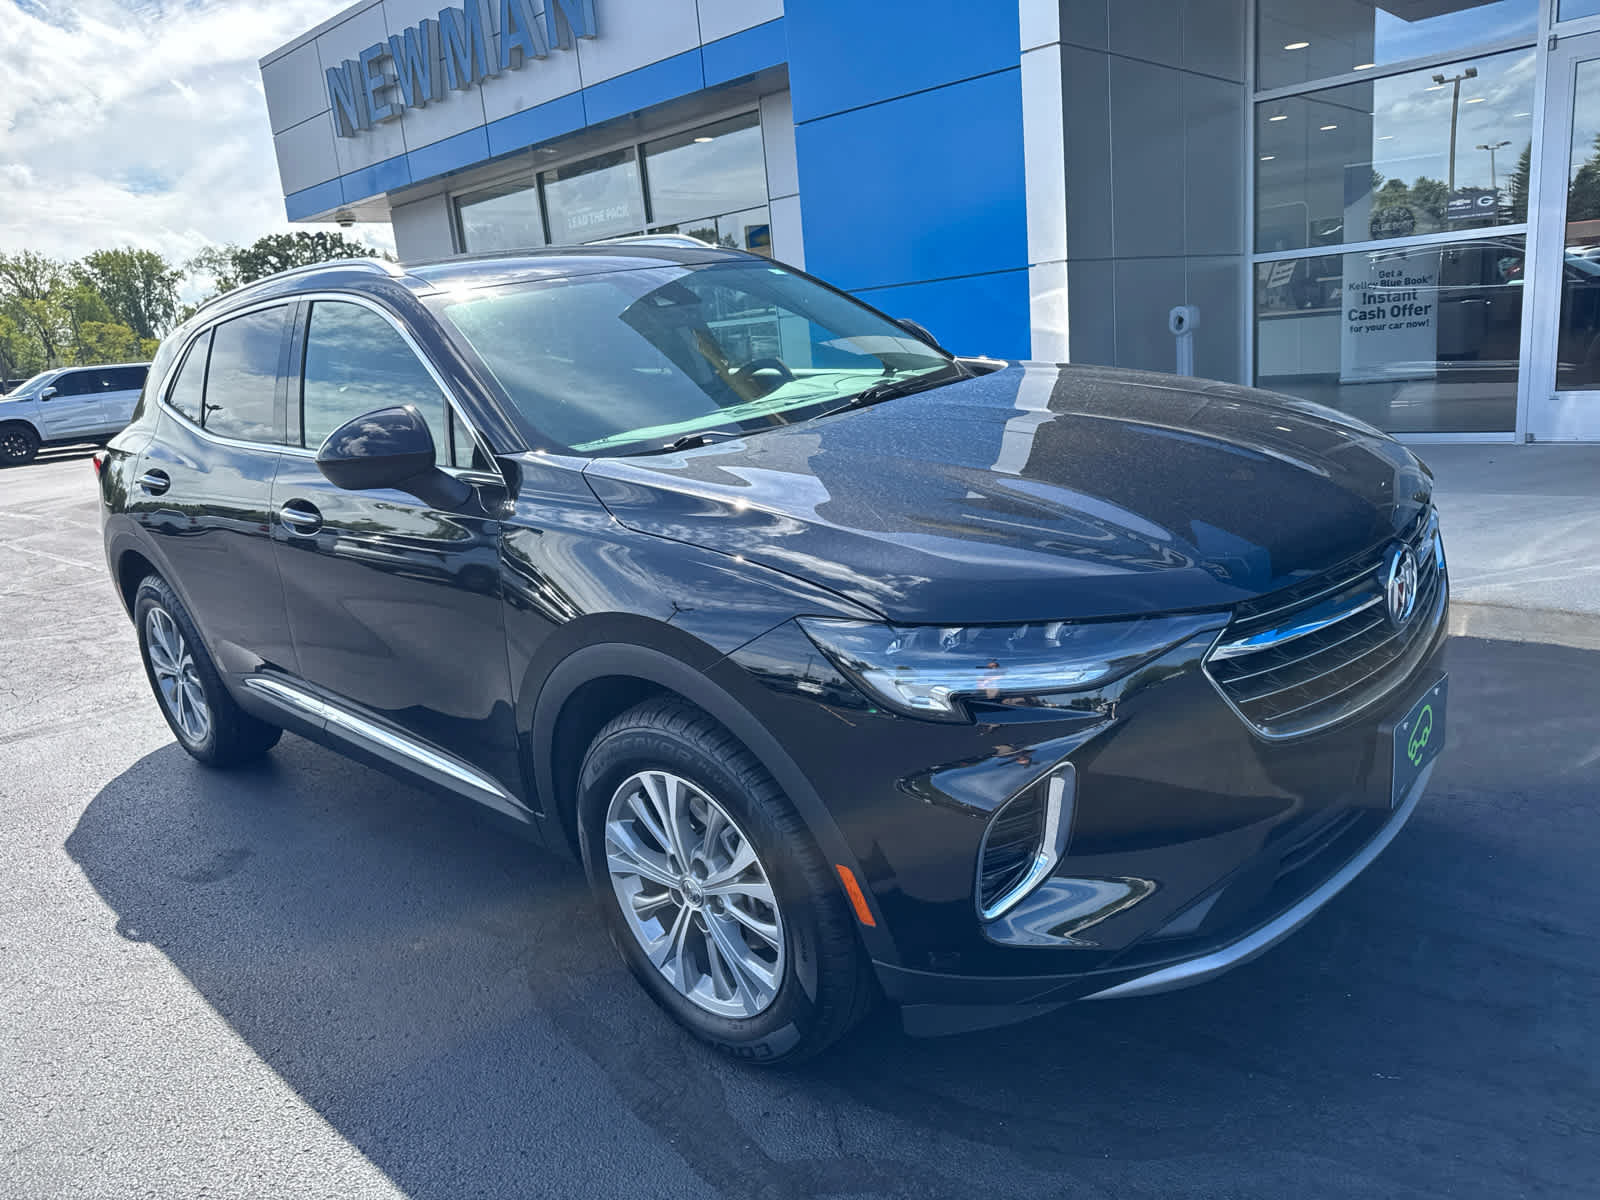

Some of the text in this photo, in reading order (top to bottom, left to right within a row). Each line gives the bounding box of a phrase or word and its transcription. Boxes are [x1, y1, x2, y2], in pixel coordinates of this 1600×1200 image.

[1378, 270, 1395, 279] Get
[1349, 280, 1378, 291] Kelley
[1380, 278, 1402, 288] Blue
[1362, 288, 1418, 305] Instant
[1348, 303, 1432, 321] Cash Offer
[1350, 318, 1430, 333] for your car now!
